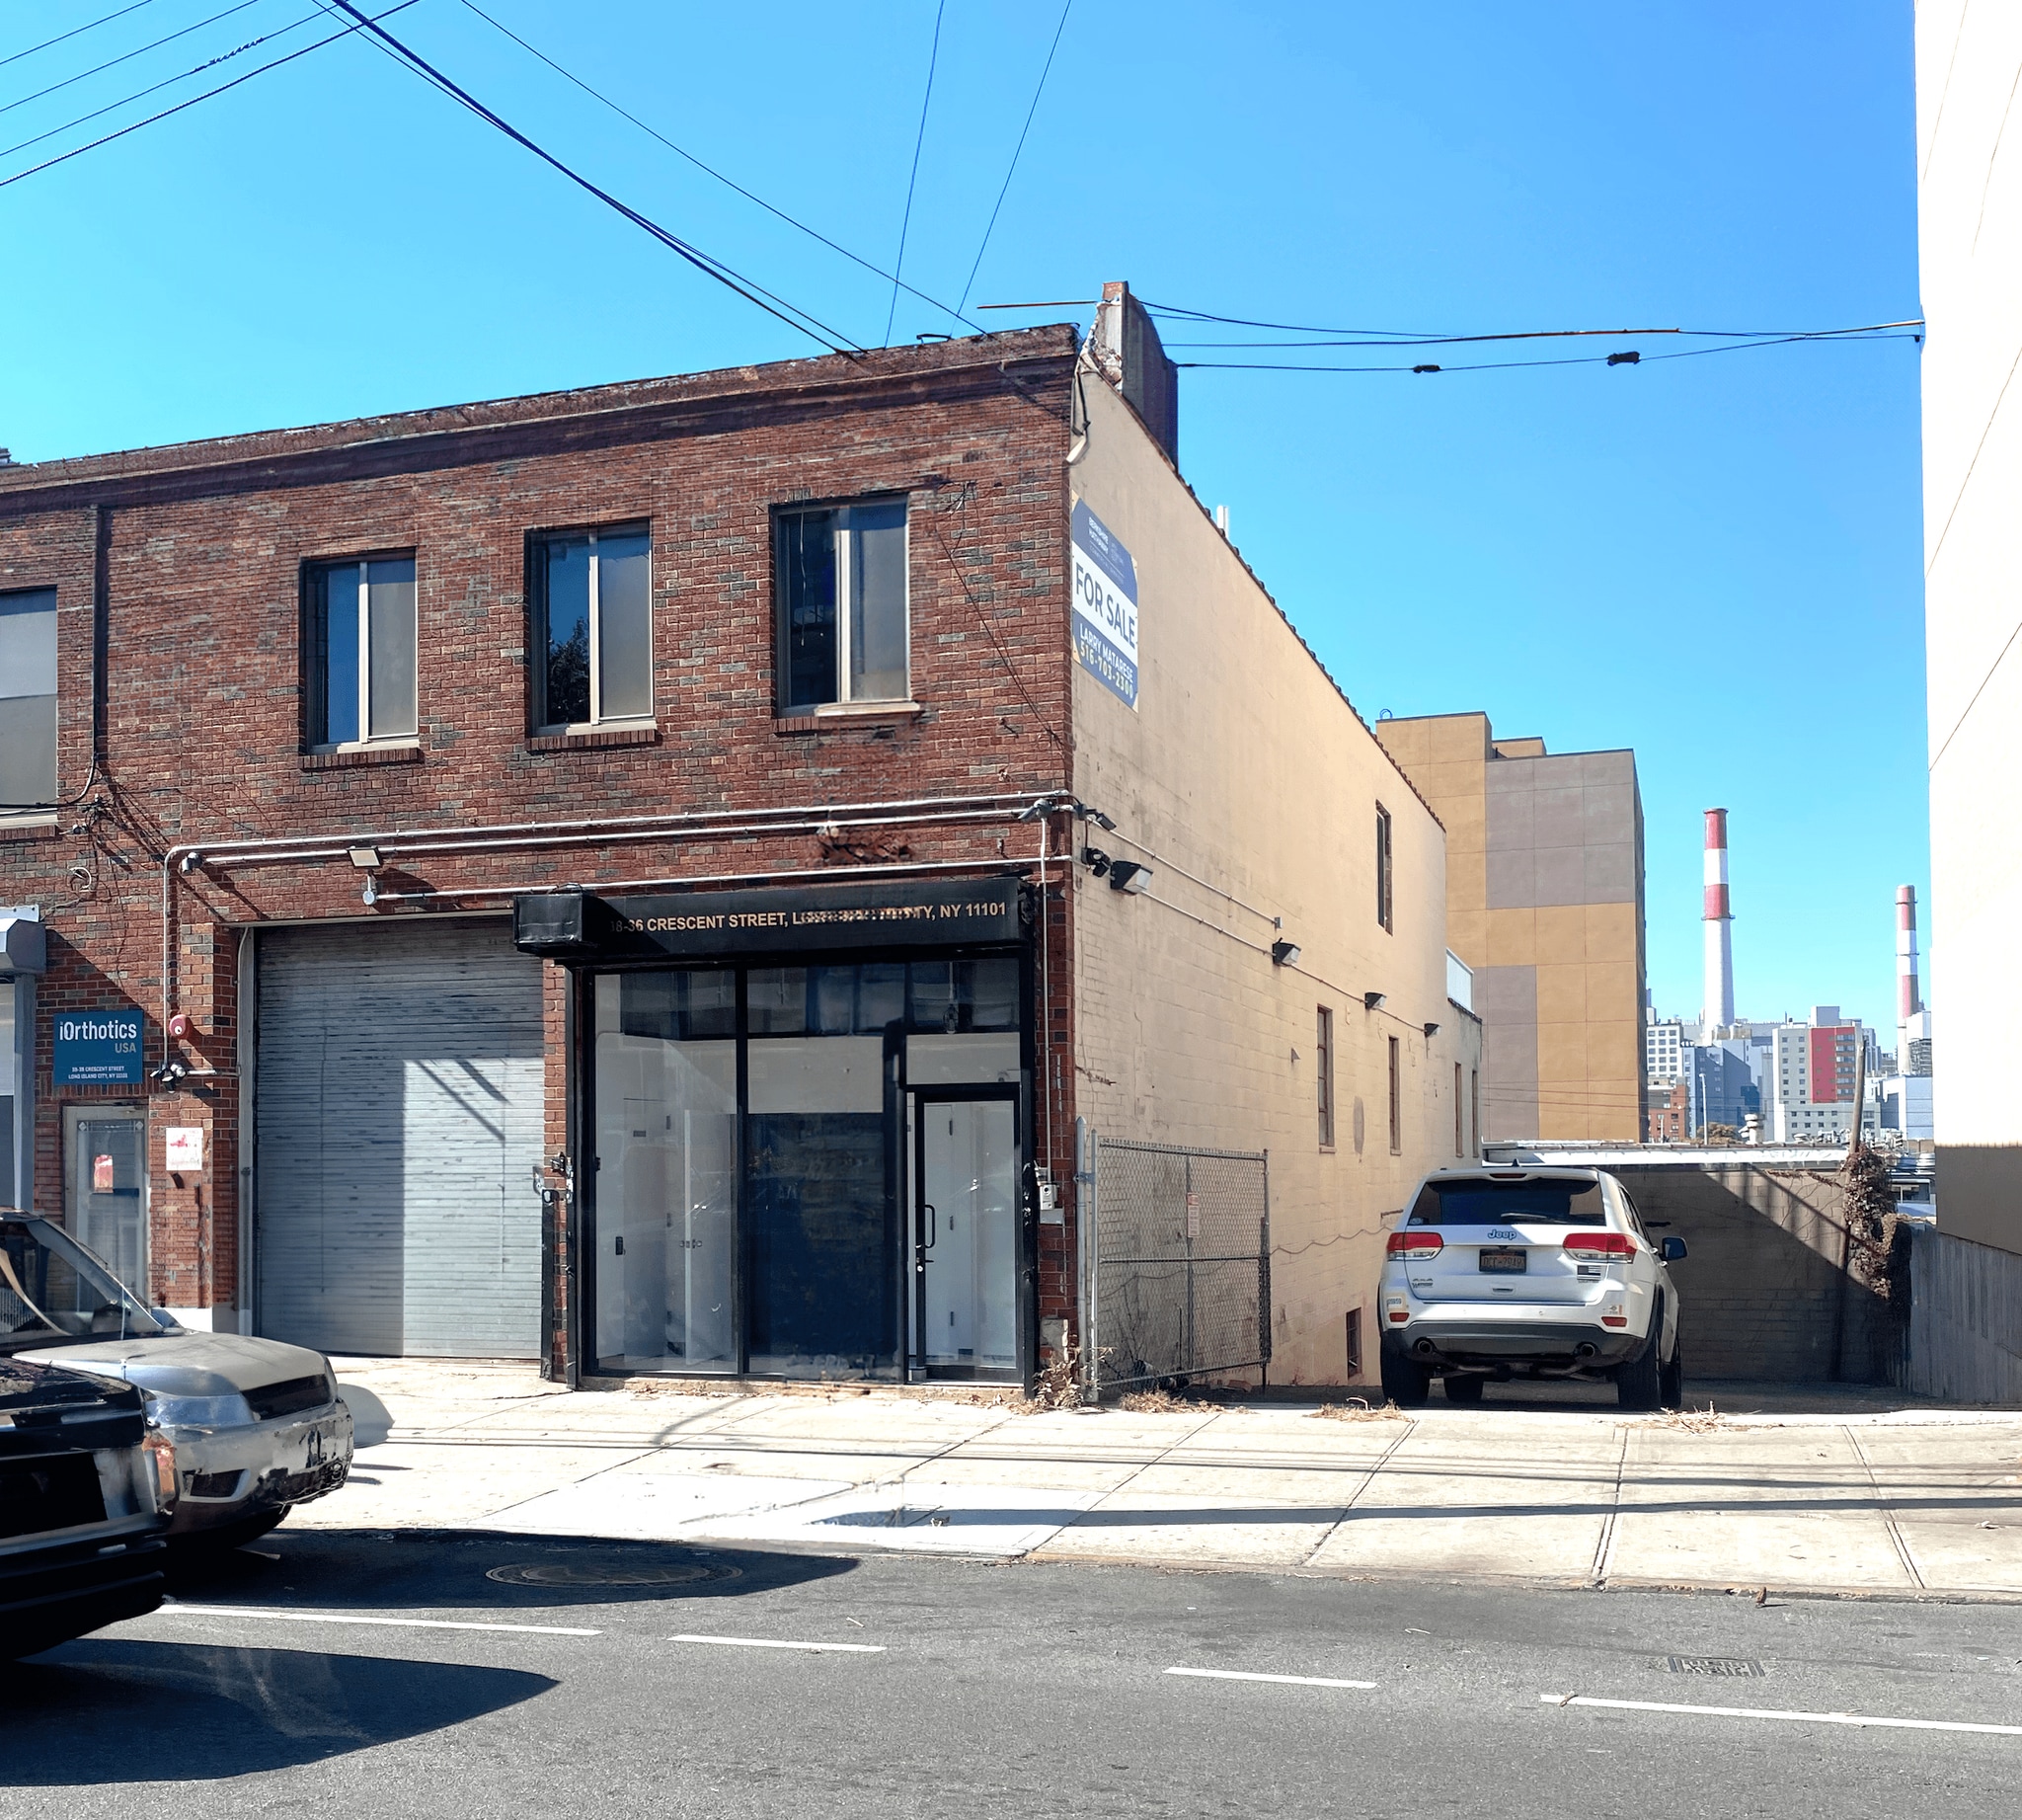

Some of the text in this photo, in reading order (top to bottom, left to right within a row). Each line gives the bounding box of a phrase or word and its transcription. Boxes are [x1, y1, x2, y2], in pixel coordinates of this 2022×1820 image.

[1076, 562, 1103, 618] FOR
[1107, 595, 1135, 649] SALE
[647, 914, 725, 931] CRESCENT
[729, 911, 789, 928] STREET,
[940, 904, 961, 918] NY
[966, 902, 1006, 916] 11101
[59, 1020, 137, 1041] iOrthotics
[115, 1042, 136, 1054] USA
[1487, 1228, 1517, 1241] Jeep
